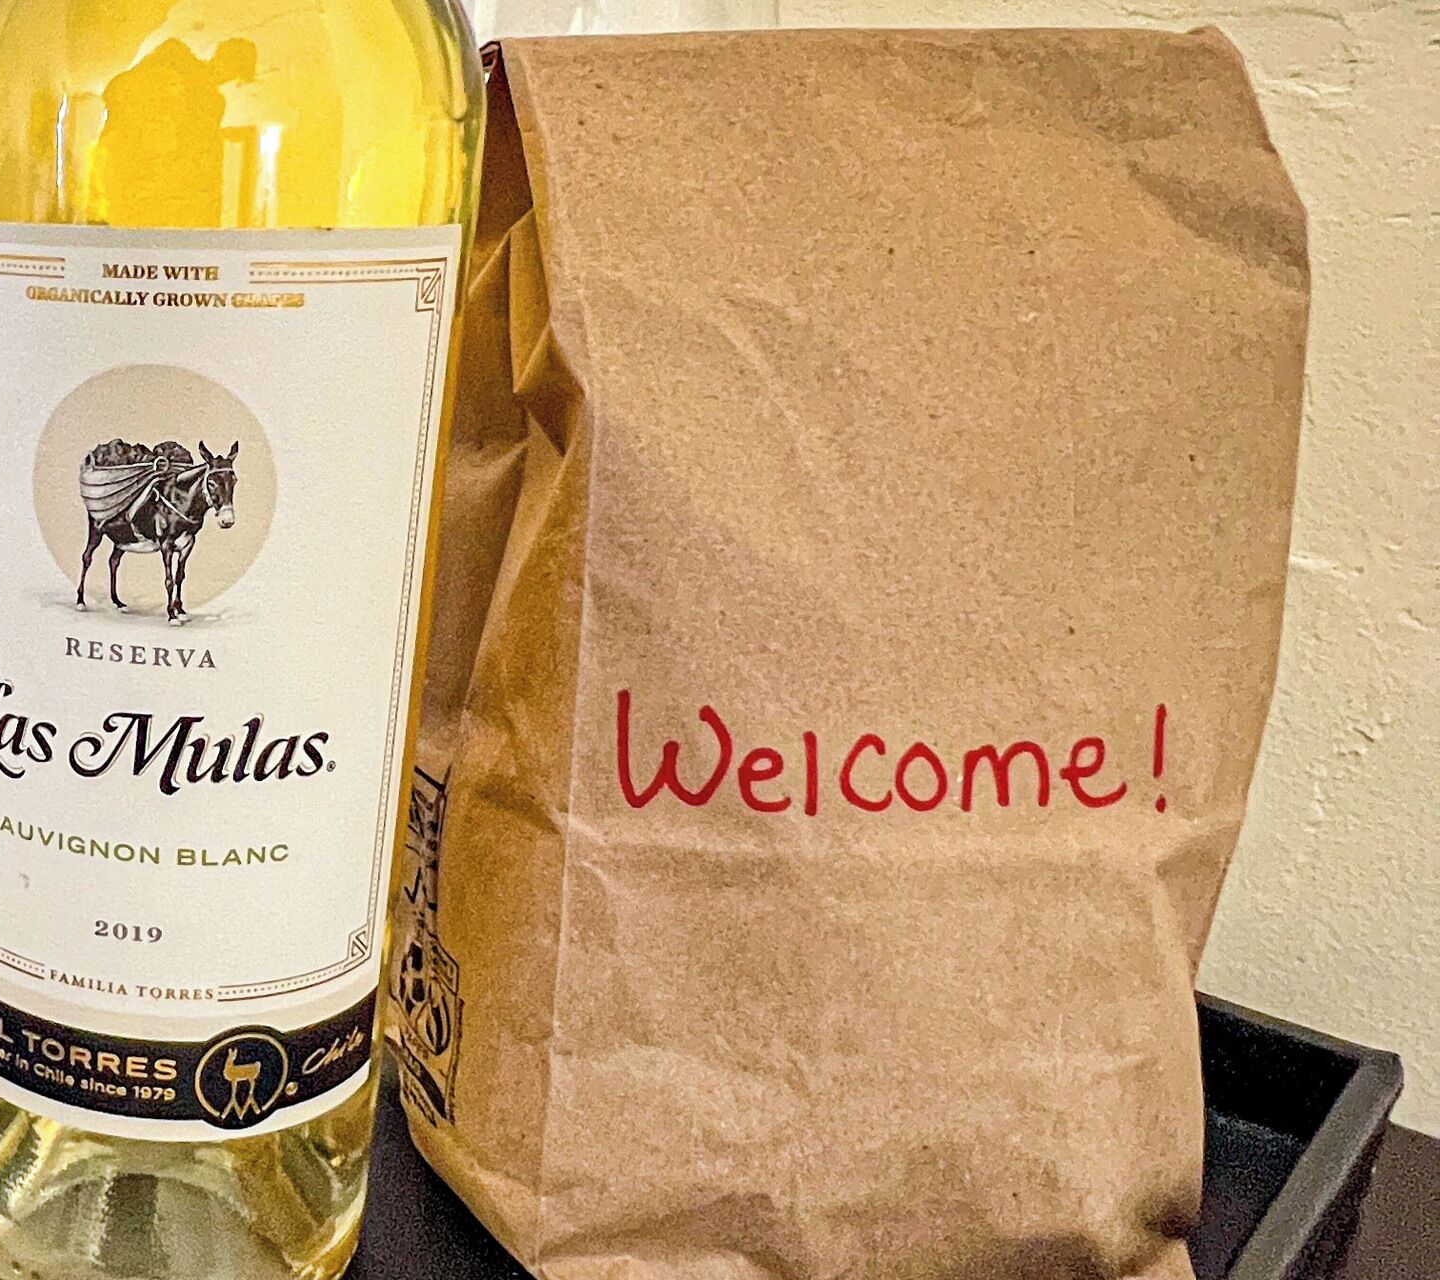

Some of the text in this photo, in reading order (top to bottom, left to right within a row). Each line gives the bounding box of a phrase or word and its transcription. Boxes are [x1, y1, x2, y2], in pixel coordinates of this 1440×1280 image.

[102, 263, 220, 281] MADE WITH
[25, 285, 150, 306] ORGANICALLY
[152, 291, 227, 308] GROWN
[65, 636, 217, 668] RESERVA
[176, 844, 290, 866] BLANC
[94, 920, 164, 943] 2019
[49, 968, 214, 1001] FAMILIA TORRES
[21, 1029, 178, 1081] TORRES
[33, 1062, 75, 1087] Chile
[80, 1077, 127, 1097] since
[131, 1085, 176, 1102] 1979
